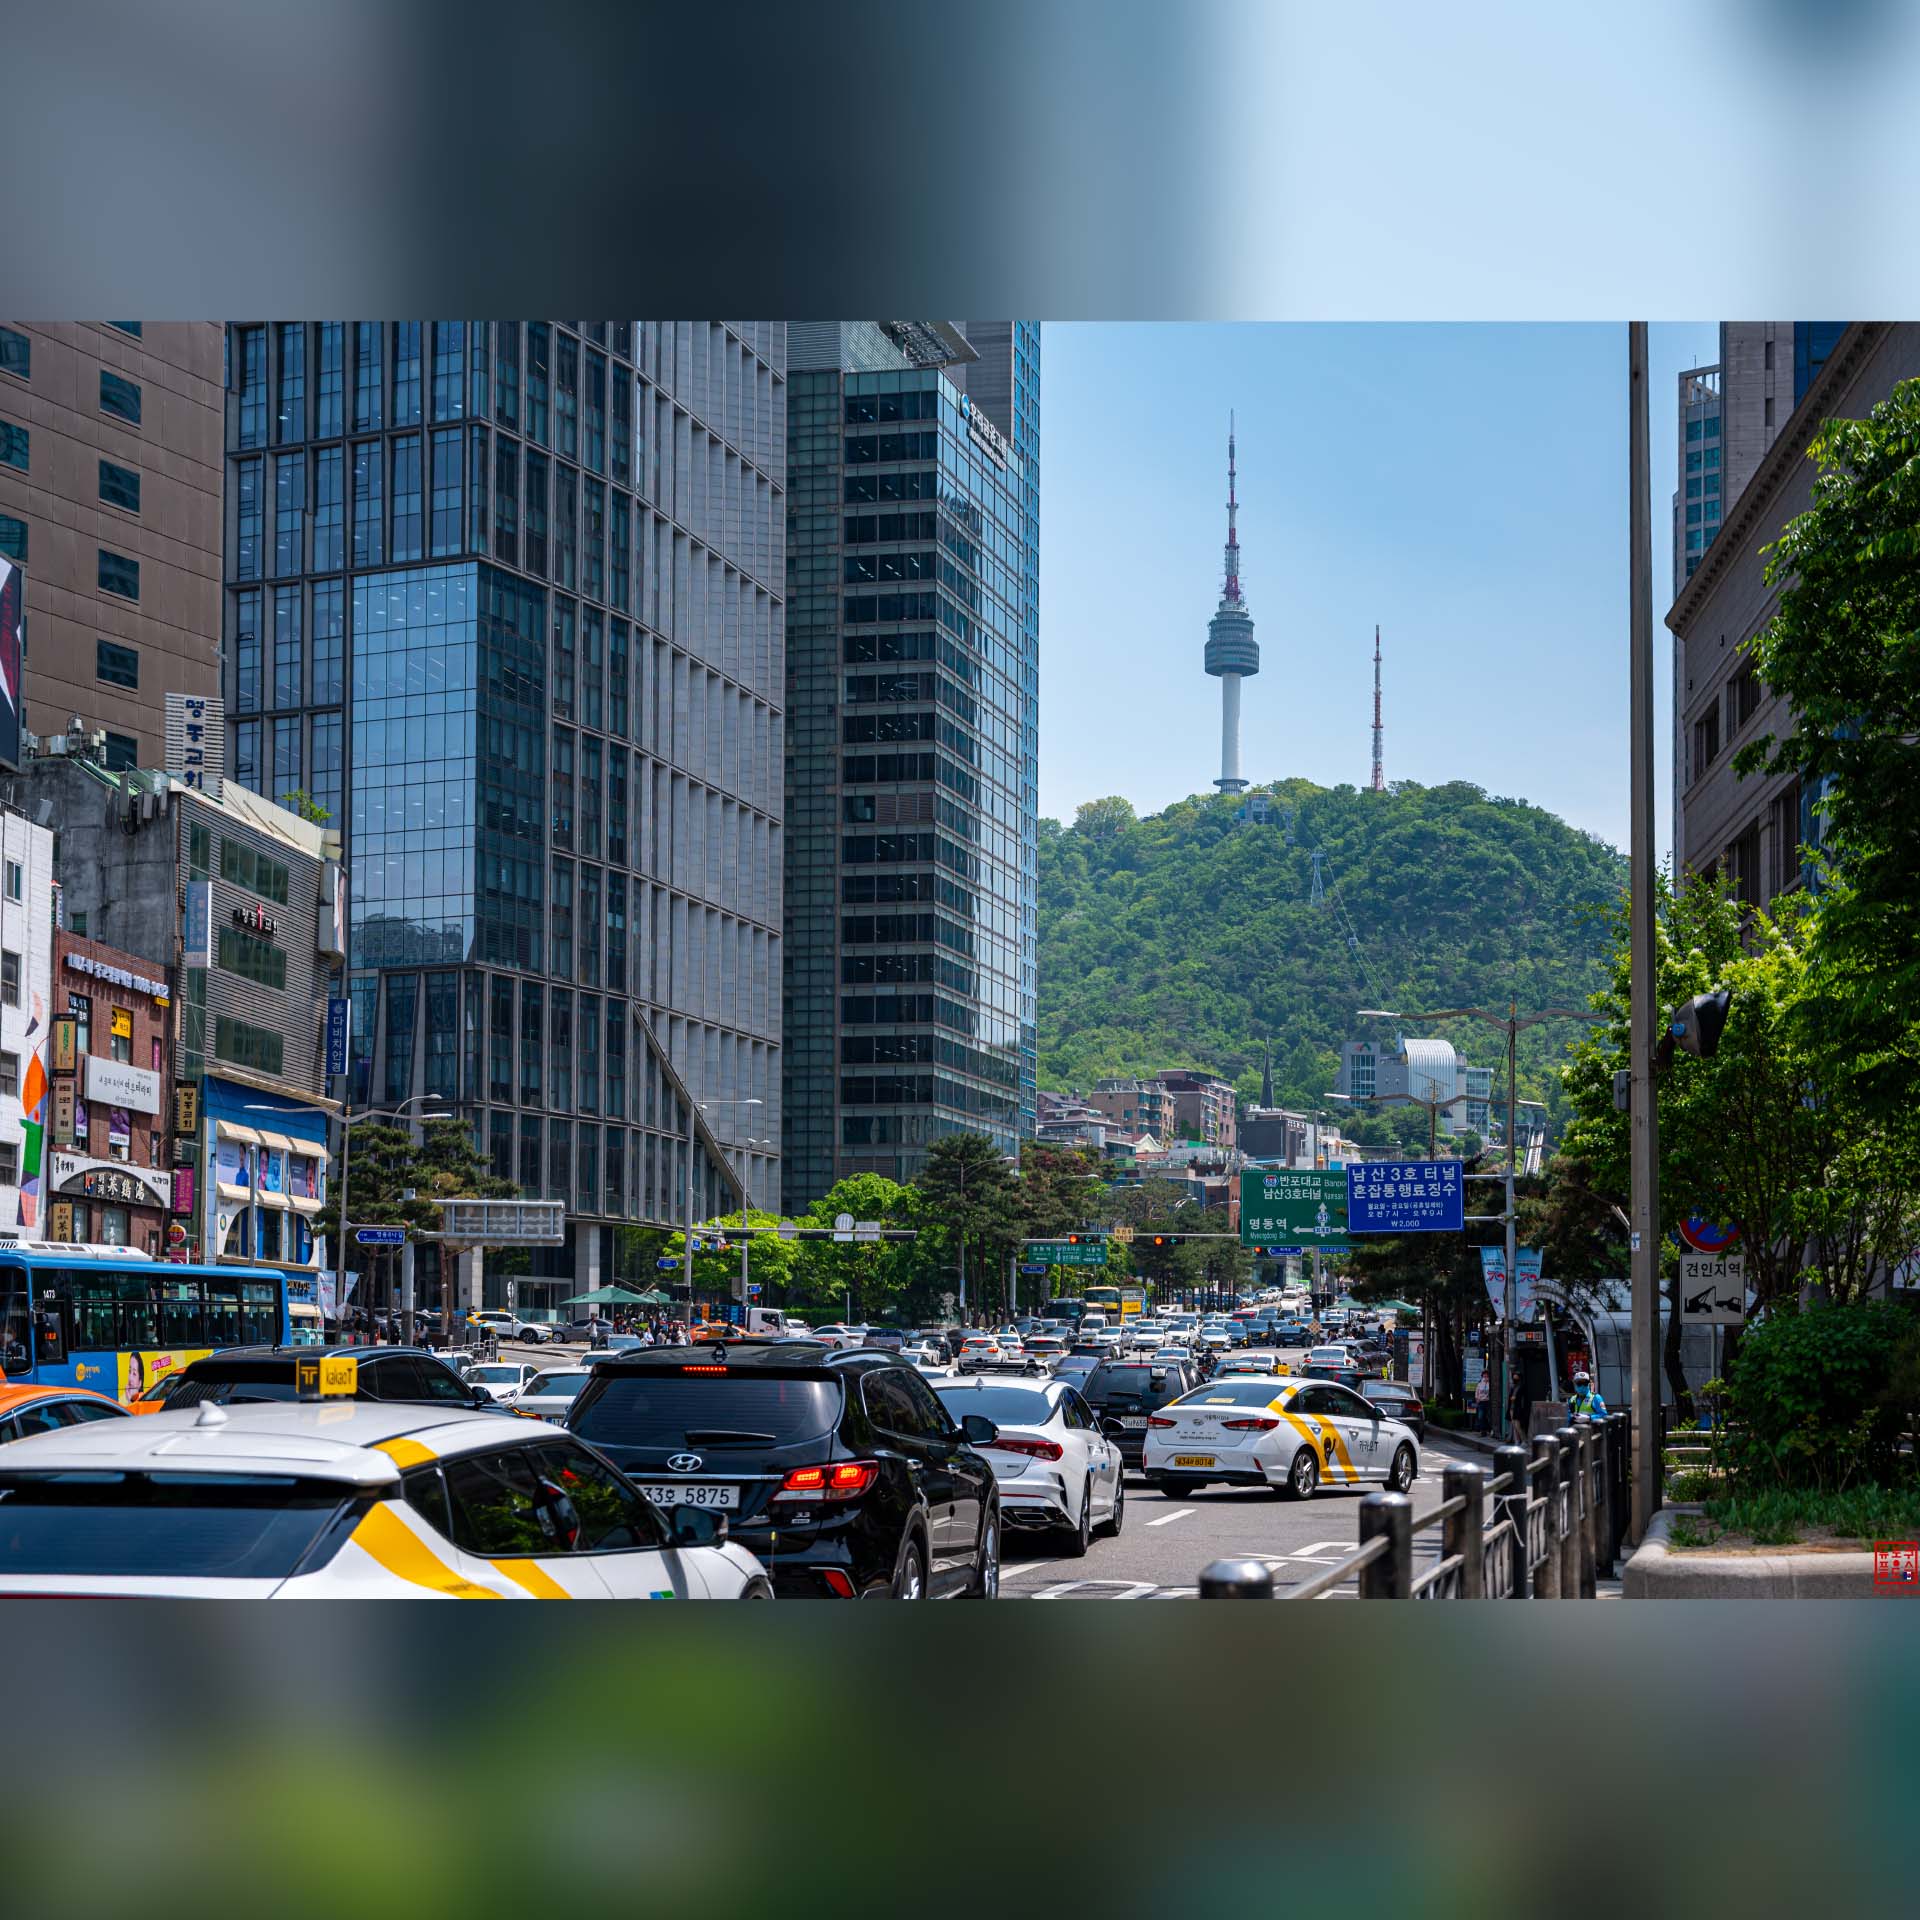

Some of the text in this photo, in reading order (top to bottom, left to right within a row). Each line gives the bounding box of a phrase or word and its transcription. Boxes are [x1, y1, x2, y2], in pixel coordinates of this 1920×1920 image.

[183, 699, 206, 790] 명동교회
[332, 1016, 344, 1073] 다비치안경
[1280, 1175, 1321, 1187] 반포대교
[1263, 1188, 1321, 1200] 남산3호터널
[1352, 1182, 1456, 1199] 혼잡통행료징수
[1249, 1217, 1287, 1230] 명동역
[1686, 1262, 1740, 1278] 견인지역
[43, 1289, 55, 1299] 1473
[685, 1488, 730, 1504] 5875
